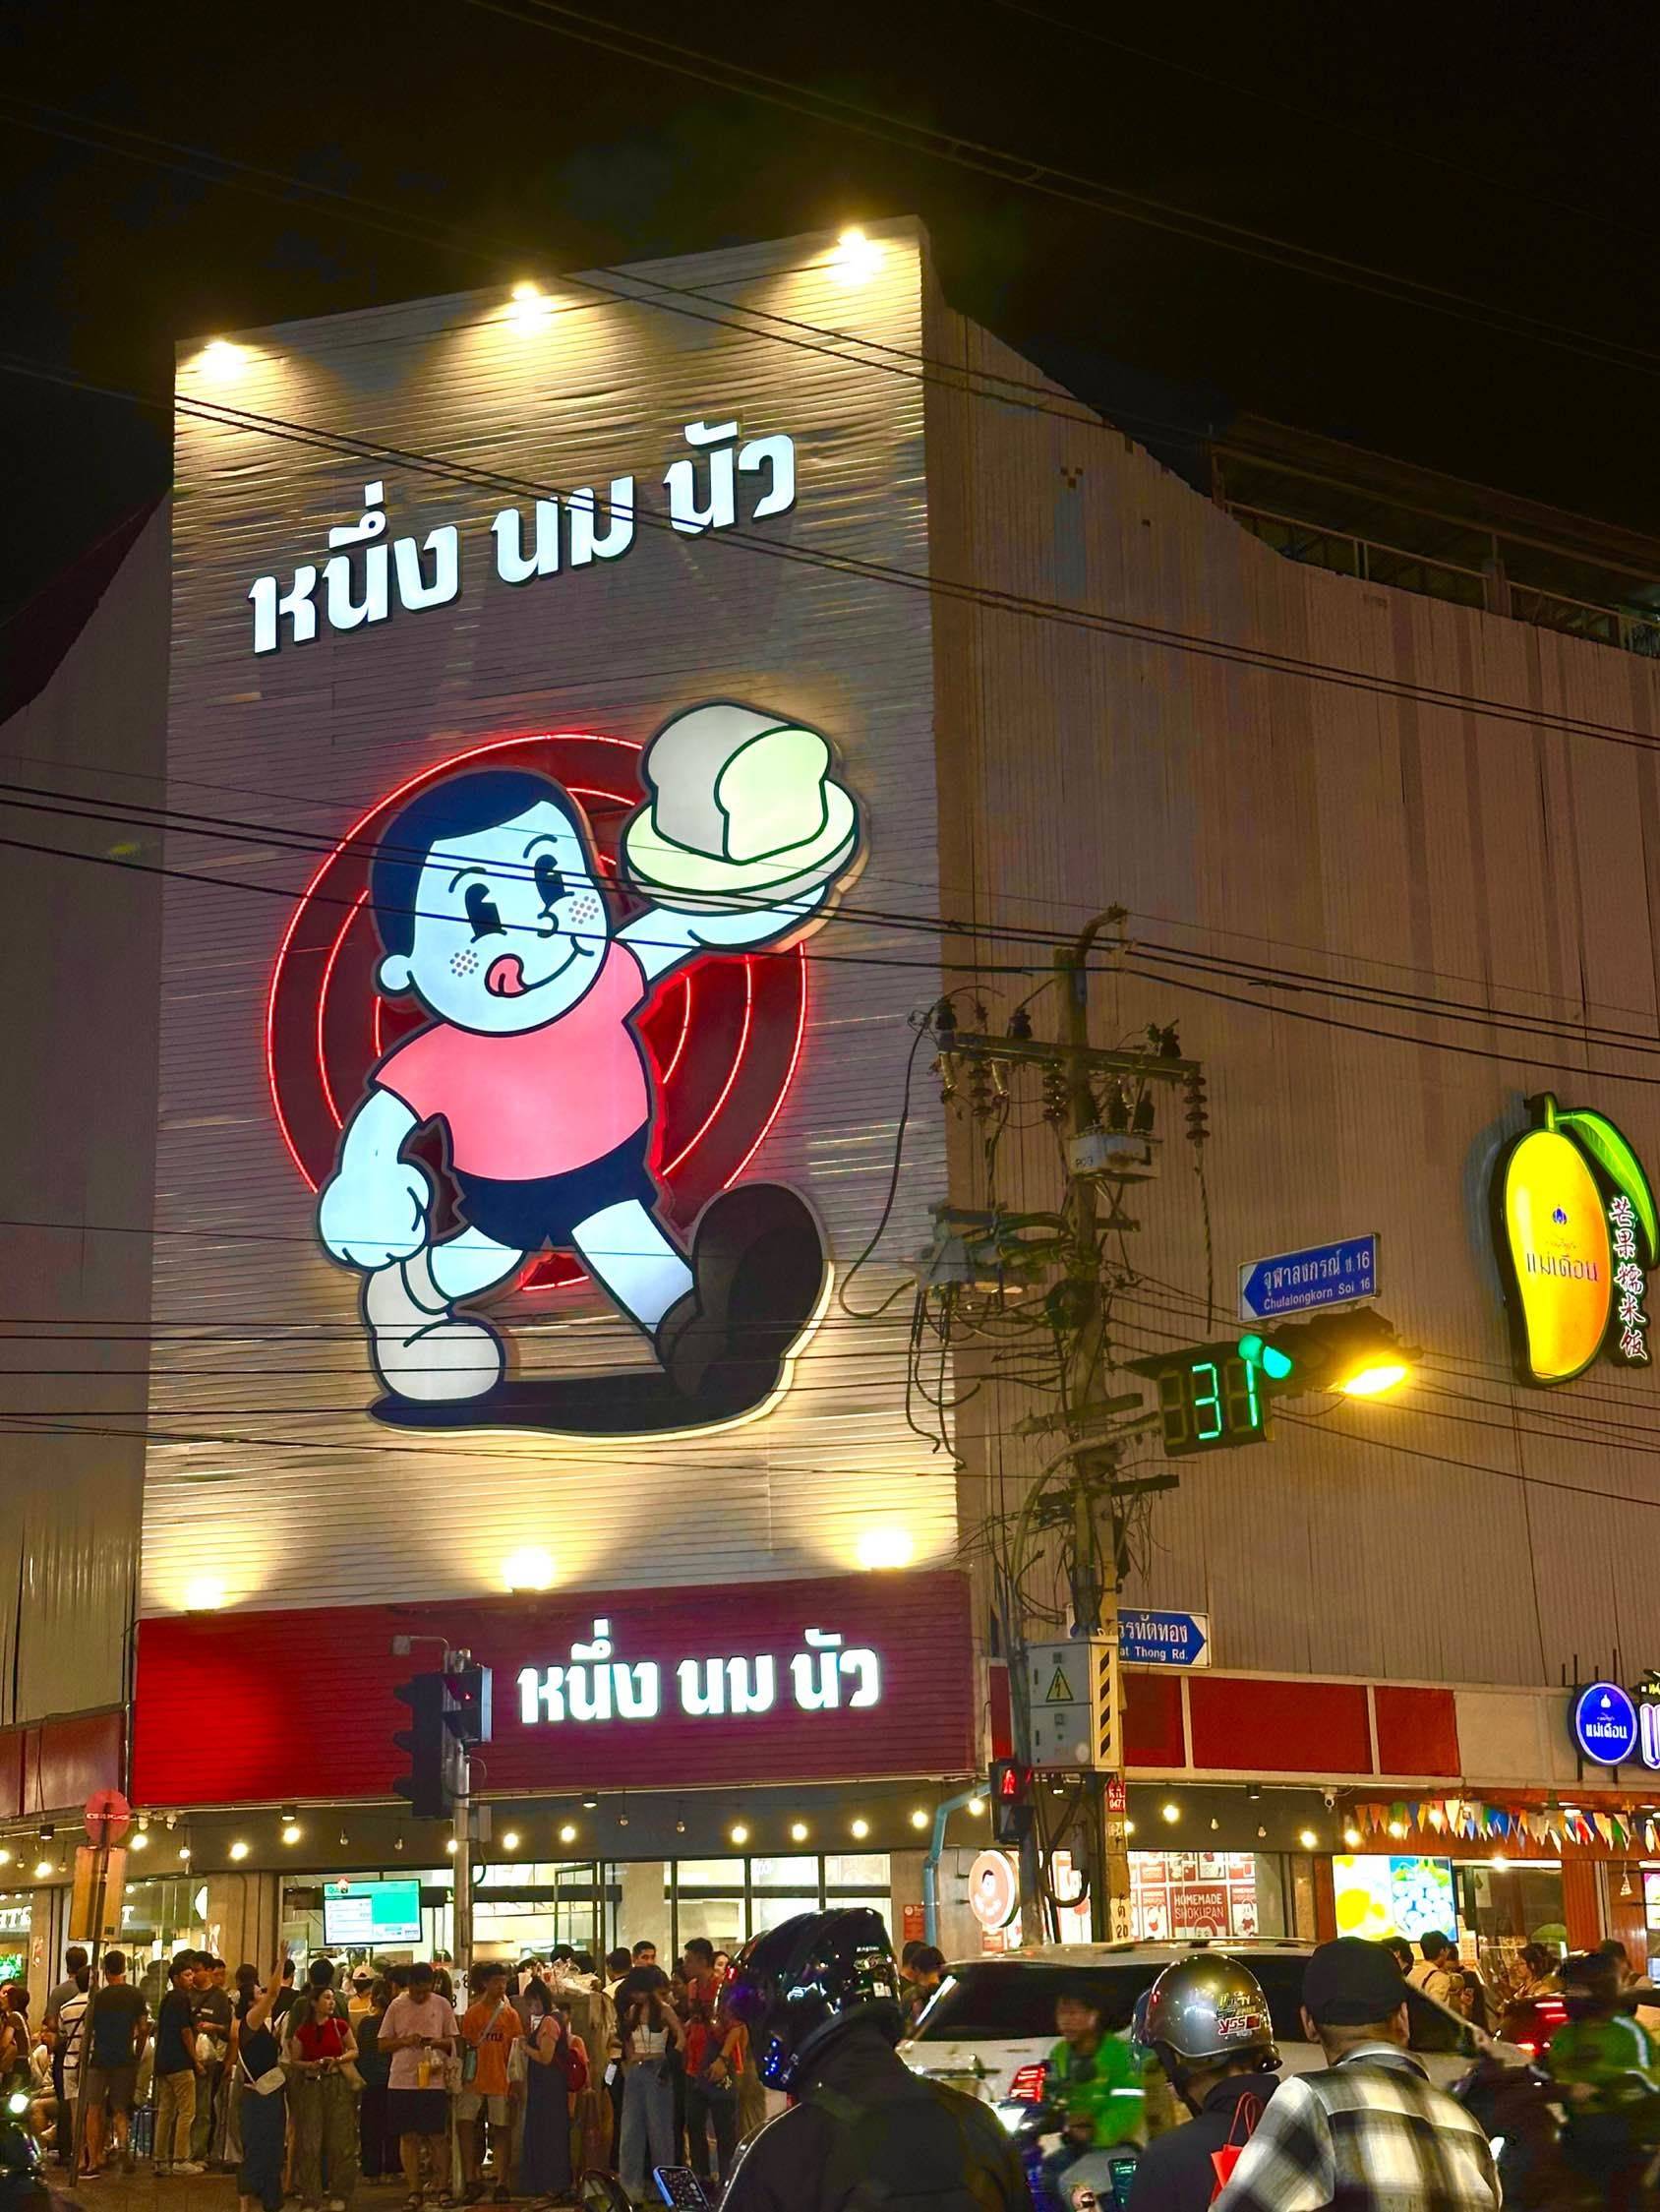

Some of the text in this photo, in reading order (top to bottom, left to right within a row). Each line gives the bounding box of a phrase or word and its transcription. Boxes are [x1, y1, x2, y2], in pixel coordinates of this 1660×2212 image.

[248, 420, 797, 655] หนึ่ง นม นัว
[1263, 1248, 1342, 1297] จุฬาลงกรณ์
[1609, 1196, 1647, 1360] 芒果糯米饭
[1263, 1277, 1371, 1311] Chulalongkorn Soi 16
[1192, 1359, 1258, 1440] 31
[1118, 1614, 1188, 1643] รรทัดทอง
[516, 1618, 880, 1724] หนึ่ง นม นัว
[1134, 1645, 1167, 1661] Thong
[1171, 1648, 1189, 1660] Rd.
[1174, 1893, 1223, 1906] HOMEMADE
[1116, 1924, 1129, 1939] 20
